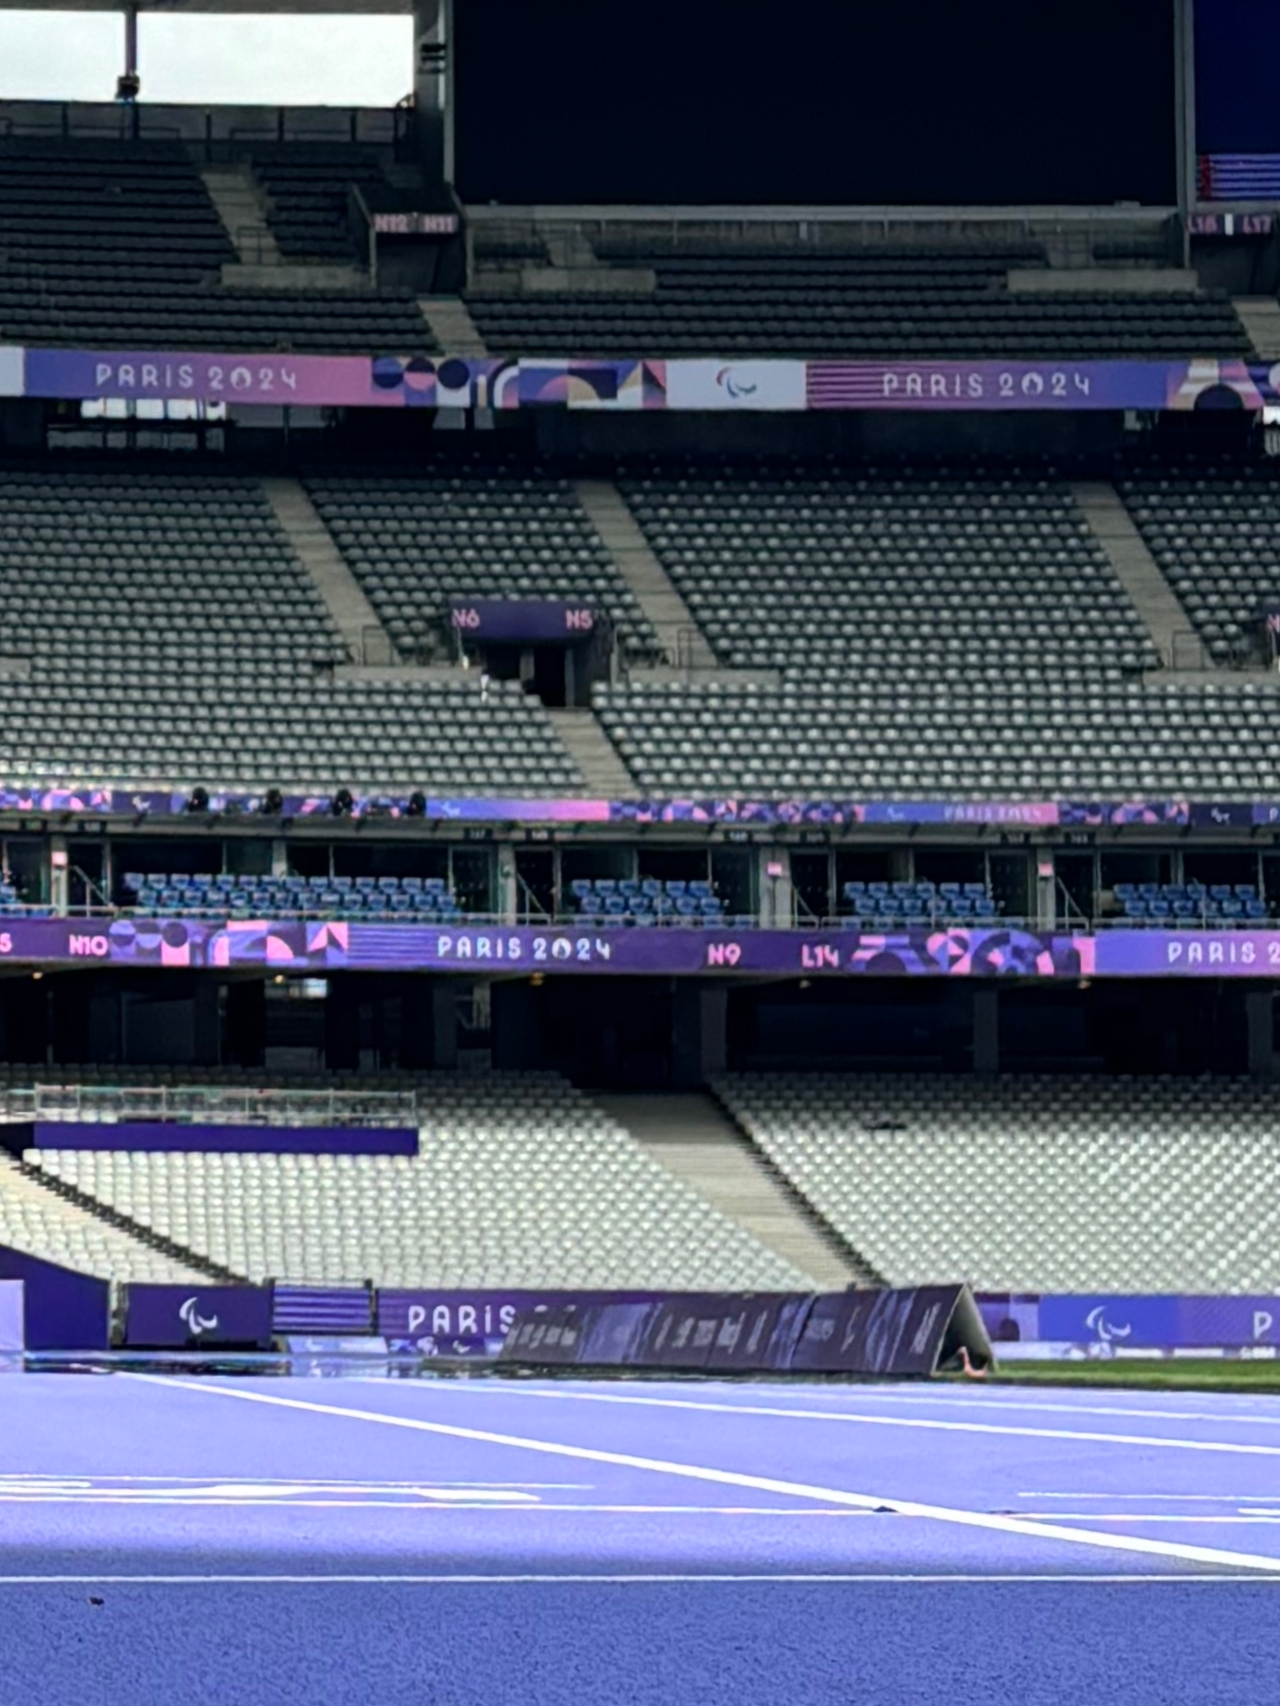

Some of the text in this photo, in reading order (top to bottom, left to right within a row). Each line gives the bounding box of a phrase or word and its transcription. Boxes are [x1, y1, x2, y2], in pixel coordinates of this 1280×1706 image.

[96, 363, 296, 391] PARIS 2024
[883, 372, 1090, 397] PARIS 2024
[451, 608, 480, 628] N6
[69, 935, 108, 956] N10
[437, 936, 610, 960] PARIS 2024
[708, 943, 839, 968] N9 L14
[1168, 941, 1256, 964] PARIS
